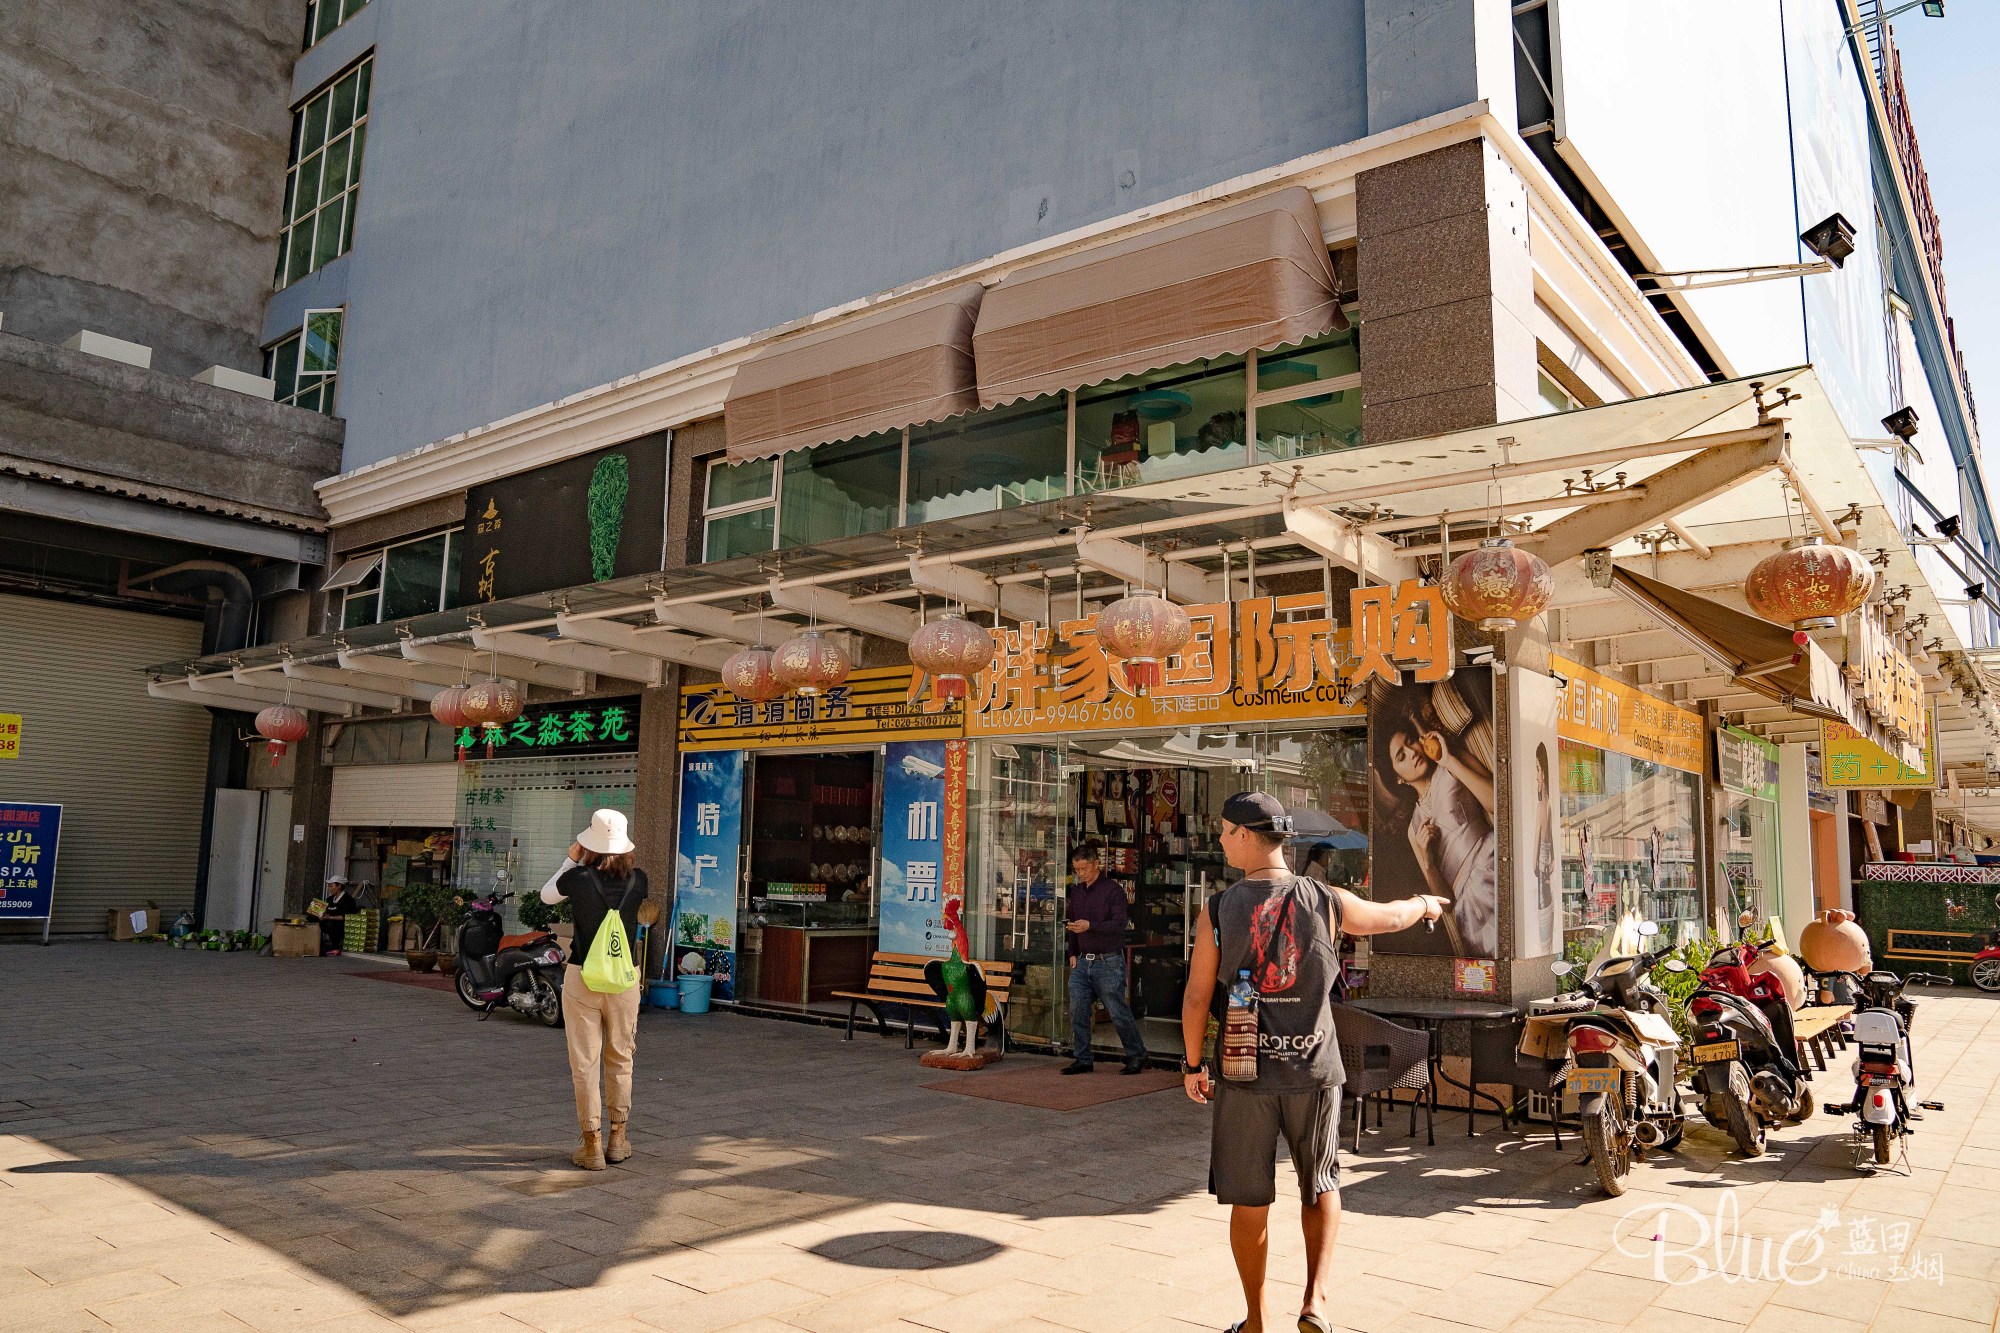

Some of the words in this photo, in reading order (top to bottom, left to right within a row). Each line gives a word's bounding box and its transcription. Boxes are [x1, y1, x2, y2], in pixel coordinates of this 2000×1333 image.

[973, 699, 1136, 729] TEL:020-99467566
[11, 845, 41, 864] 所
[694, 802, 721, 889] 特产
[906, 801, 938, 903] 机票
[1, 866, 35, 877] SPA
[1270, 1035, 1291, 1050] OF
